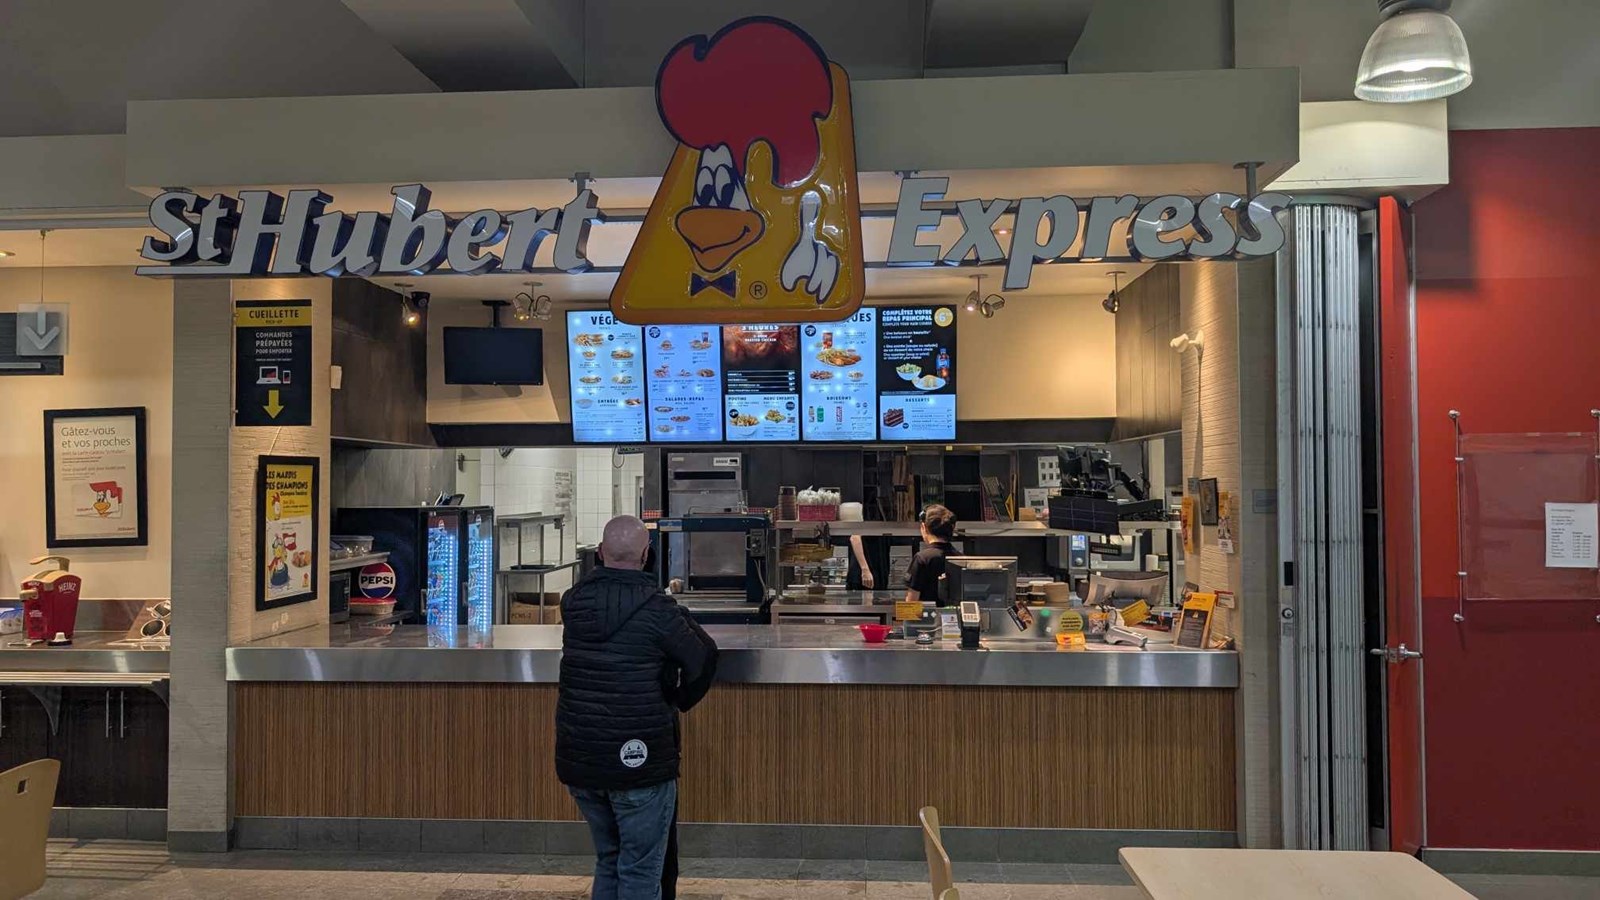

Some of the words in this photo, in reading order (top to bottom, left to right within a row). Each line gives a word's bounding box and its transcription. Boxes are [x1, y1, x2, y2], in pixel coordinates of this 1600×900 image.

[886, 176, 1294, 291] Express
[248, 309, 299, 319] CUEILLETTE
[255, 339, 293, 347] PRÉPAYÉES
[60, 426, 116, 437] Gâtez-vous
[61, 440, 71, 448] et
[75, 440, 91, 448] vos
[93, 437, 131, 449] proches
[276, 471, 297, 479] MARDIS
[276, 481, 309, 490] CHAMPIONS
[361, 576, 394, 585] PEPSI
[58, 581, 77, 593] HEINZ
